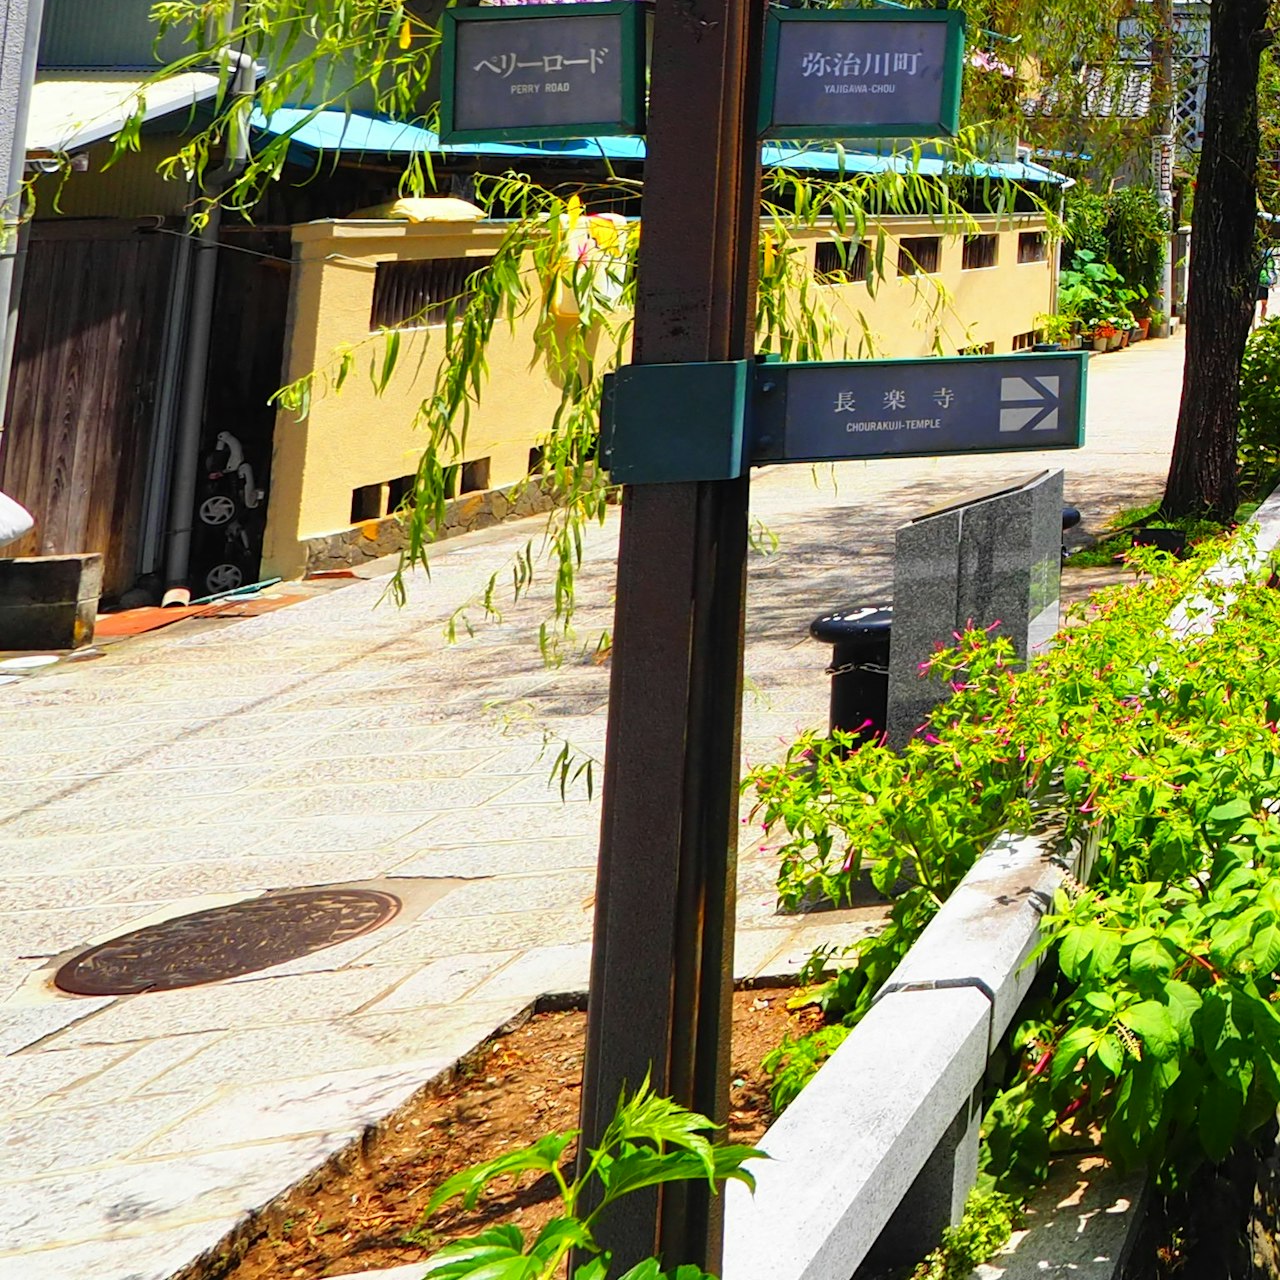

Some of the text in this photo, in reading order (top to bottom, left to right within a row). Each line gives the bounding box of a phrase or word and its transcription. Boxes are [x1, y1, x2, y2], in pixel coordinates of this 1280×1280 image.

[473, 47, 609, 78] ペリーロード
[801, 52, 923, 77] 弥治川町
[510, 82, 570, 95] PERRY ROAD
[824, 84, 895, 94] YAJIGAWA-CHOU
[833, 387, 955, 413] 長楽寺
[846, 418, 941, 433] CHOURAKUJI-TEMPLE
